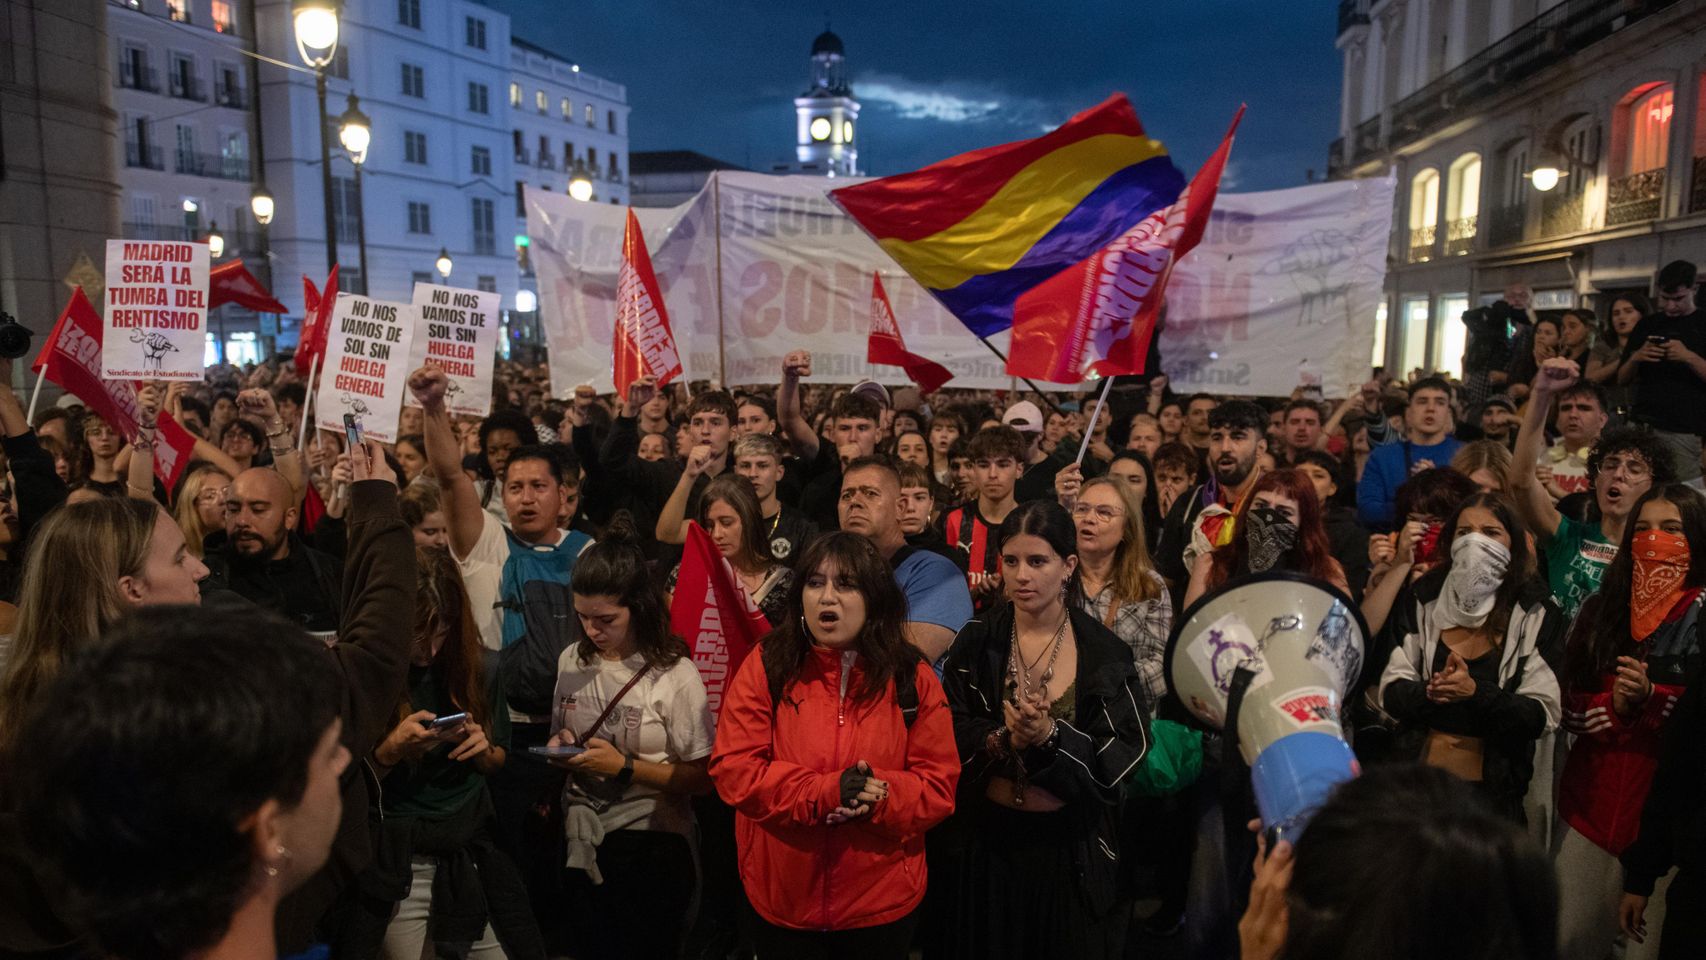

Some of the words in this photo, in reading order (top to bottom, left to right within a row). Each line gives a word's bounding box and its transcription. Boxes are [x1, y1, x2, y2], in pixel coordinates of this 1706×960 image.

[124, 243, 193, 263] MADRID
[122, 261, 165, 284] SERÁ
[171, 266, 192, 285] LA
[108, 287, 168, 306] TUMBA
[175, 289, 206, 309] DEL
[432, 289, 450, 305] NO
[453, 292, 479, 309] NOS
[112, 309, 200, 331] RENTISMO
[351, 300, 370, 318] NO
[372, 303, 397, 323] NOS
[422, 305, 467, 325] VAMOS
[470, 312, 486, 328] DE
[341, 317, 384, 340] VAMOS
[386, 326, 403, 343] DE
[428, 323, 452, 340] SOL
[455, 327, 476, 344] SIN
[344, 337, 366, 356] SOL
[369, 342, 391, 361] SIN
[427, 340, 475, 361] HUELGA
[107, 368, 142, 377] Sindicato
[144, 368, 152, 377] de
[153, 369, 200, 379] Estudiantes
[340, 356, 386, 380] HUELGA
[335, 373, 385, 399] GENERAL
